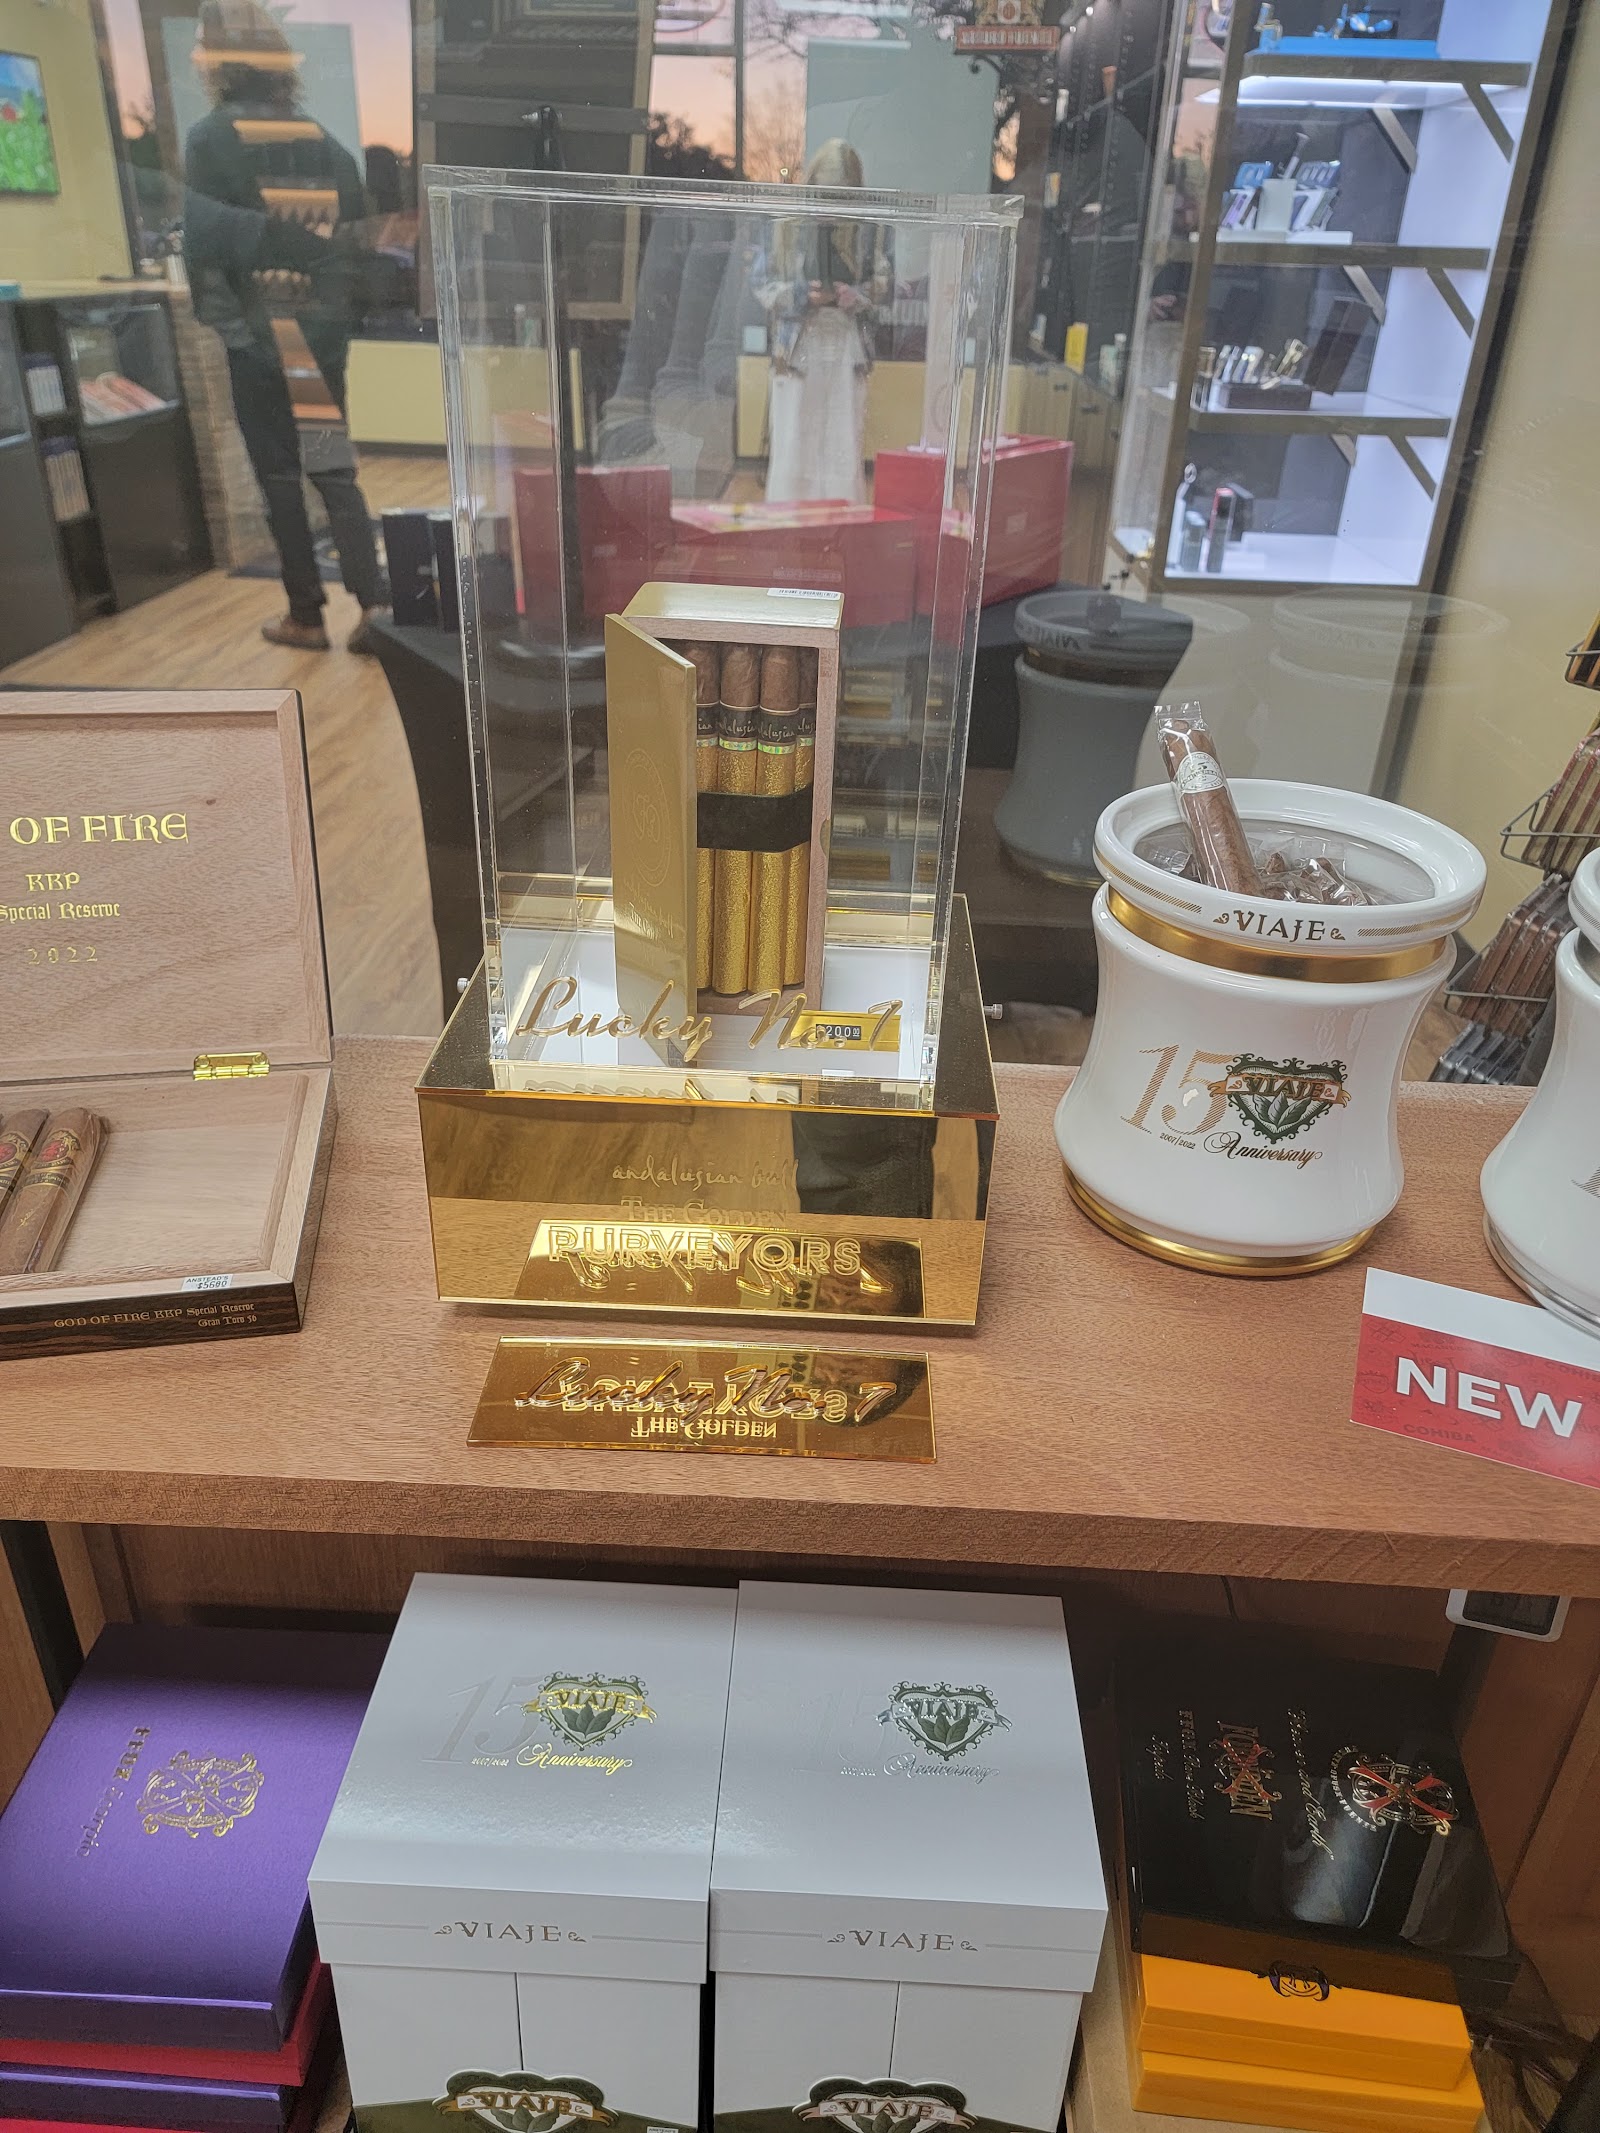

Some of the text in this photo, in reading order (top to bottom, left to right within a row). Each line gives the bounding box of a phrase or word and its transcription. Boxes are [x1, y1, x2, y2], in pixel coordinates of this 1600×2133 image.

[9, 813, 189, 845] OF FIRE
[58, 901, 121, 920] Reserve
[1233, 909, 1326, 943] VIAJE
[27, 946, 98, 965] 2022
[515, 975, 713, 1063] Lucky
[738, 988, 847, 1050] No.
[1120, 1044, 1234, 1136] 15
[1243, 1075, 1326, 1099] VIAJE
[1159, 1130, 1323, 1170] 2007/2022 Anniversary
[611, 1153, 743, 1192] andalusian
[548, 1224, 862, 1276] PURVEYORS
[54, 1317, 87, 1328] GOD
[90, 1315, 110, 1324] OF
[112, 1311, 150, 1323] FIRE
[187, 1304, 217, 1316] Special
[221, 1302, 255, 1314] Reserve
[198, 1318, 221, 1328] Gran
[515, 1356, 716, 1428] Lucky
[854, 1381, 898, 1423] 7
[1396, 1356, 1583, 1439] NEW
[1403, 1424, 1477, 1444] COHIBA
[555, 1691, 626, 1710] VIAJE
[903, 1698, 979, 1720] VIAJE
[516, 1743, 633, 1776] Anniversary
[883, 1752, 1000, 1785] Anniversary
[1298, 1768, 1321, 1806] and
[454, 1920, 562, 1944] VIAJE
[848, 1929, 955, 1953] VIAJE
[473, 2092, 572, 2116] VIAJE
[838, 2099, 936, 2119] VIAJE
